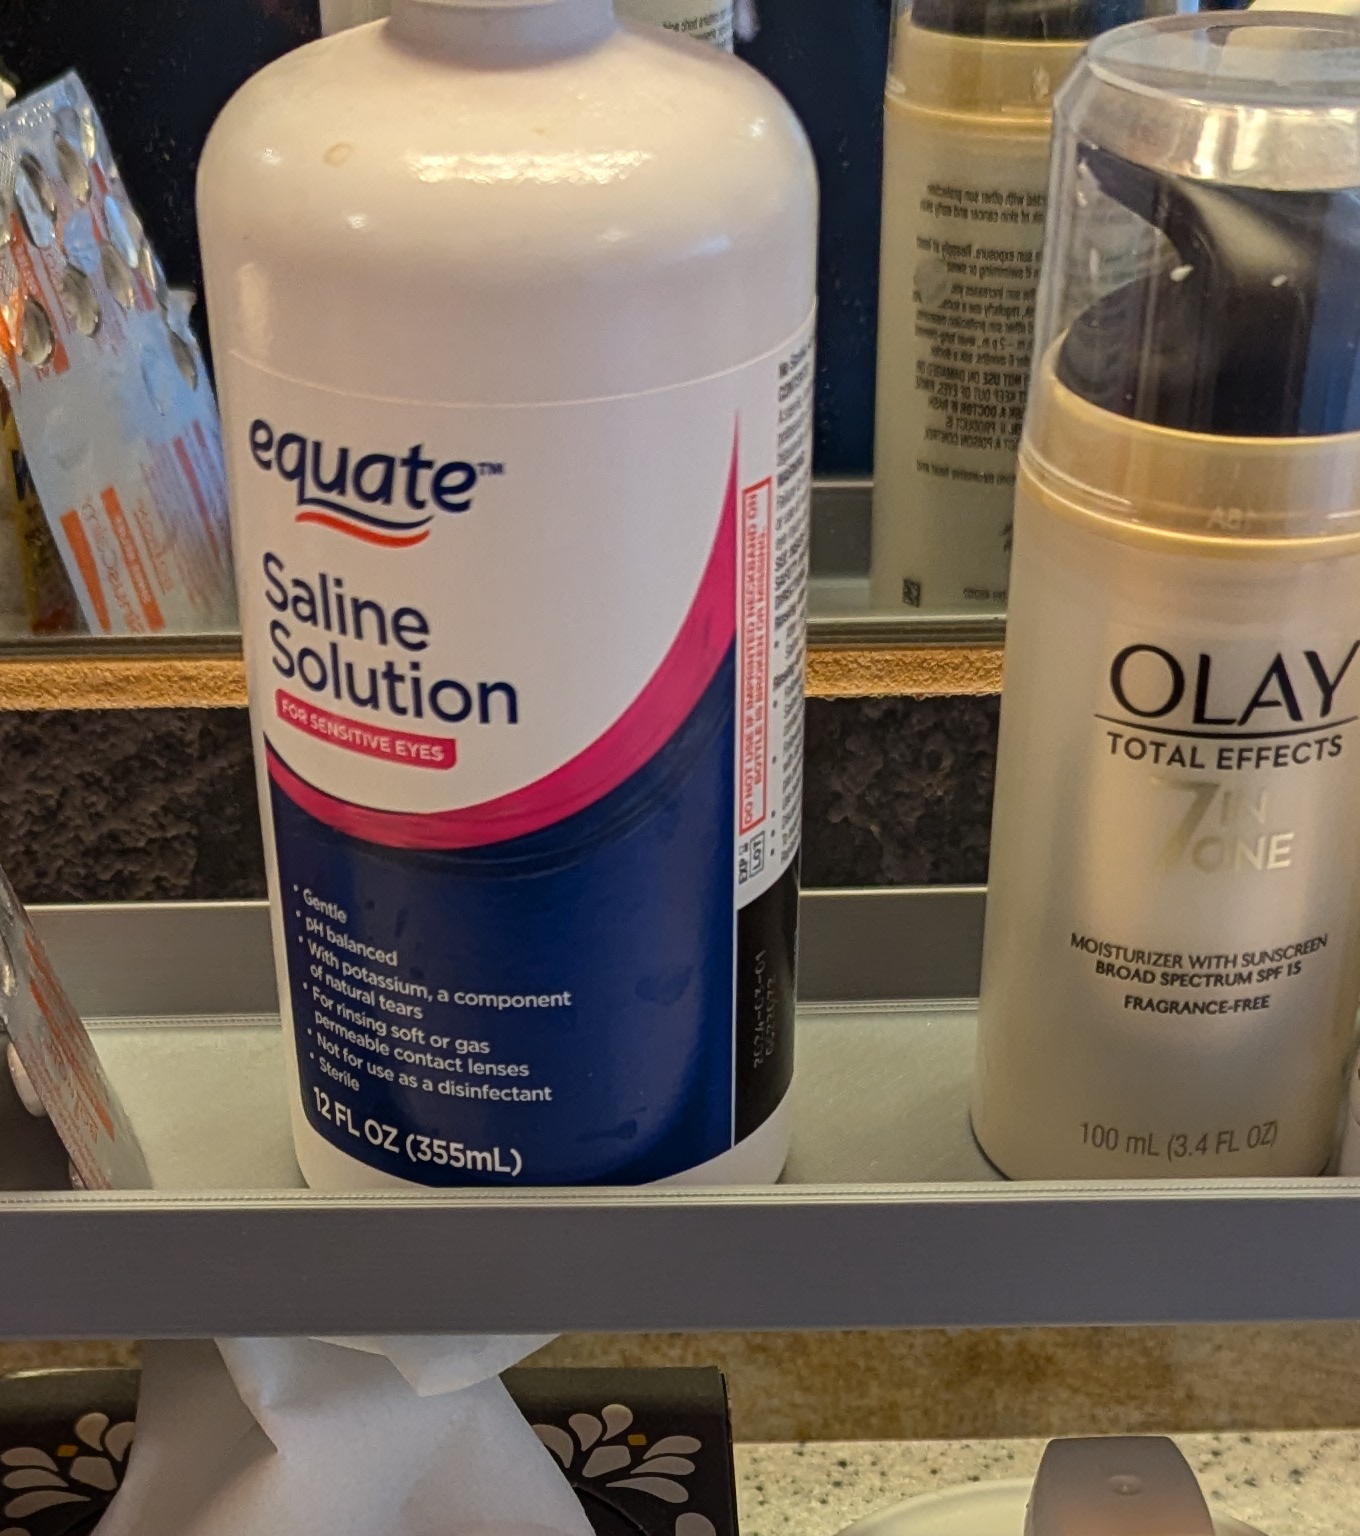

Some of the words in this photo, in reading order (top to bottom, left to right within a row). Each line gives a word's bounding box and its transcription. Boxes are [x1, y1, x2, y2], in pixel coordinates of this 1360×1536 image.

[263, 552, 430, 651] Saline
[269, 619, 518, 725] Solution
[281, 699, 308, 724] FOR
[310, 714, 391, 753] SENSITIVE
[395, 740, 444, 761] EYES
[744, 731, 754, 763] USE
[1107, 731, 1205, 769] TOTAL
[1216, 734, 1343, 770] EFFECTS
[744, 766, 754, 798] NOT
[1150, 777, 1220, 872] 7
[1191, 833, 1295, 874] ONE
[303, 888, 347, 923] Gentle
[306, 917, 324, 937] pH
[326, 925, 398, 967] balanced
[1070, 933, 1183, 969] MOISTURIZER
[1188, 953, 1238, 970] WITH
[1241, 934, 1328, 967] SUNSCREEN
[307, 939, 339, 969] With
[342, 961, 433, 1002] potassium,
[437, 989, 449, 1002] a
[454, 991, 572, 1010] component
[310, 964, 323, 980] of
[326, 974, 375, 1006] natural
[379, 994, 423, 1019] tears
[1095, 961, 1156, 985] BROAD
[1160, 971, 1252, 989] SPECTRUM
[1256, 965, 1283, 983] SPF
[1286, 961, 1302, 978] 15
[313, 986, 334, 1010] For
[337, 1003, 387, 1036] rinsing
[391, 1025, 426, 1045] soft
[430, 1035, 450, 1049] or
[455, 1039, 490, 1054] gas
[1123, 995, 1271, 1016] FRAGRANCE-FREE
[315, 1011, 390, 1056] permeable
[394, 1047, 463, 1073] contact
[468, 1058, 529, 1077] lenses
[317, 1032, 340, 1059] Not
[343, 1048, 363, 1069] for
[367, 1062, 394, 1081] use
[398, 1073, 418, 1088] as
[422, 1079, 433, 1092] a
[438, 1080, 552, 1101] disinfectant
[319, 1056, 360, 1091] Sterile
[313, 1086, 332, 1120] 12
[335, 1101, 360, 1138] FL
[364, 1119, 400, 1153] OZ
[406, 1133, 523, 1177] (355mL)
[1080, 1122, 1118, 1151] 100
[1125, 1134, 1160, 1158] mL
[1166, 1129, 1209, 1161] (3.4
[1216, 1129, 1240, 1154] FL
[1246, 1121, 1279, 1149] OZ)
